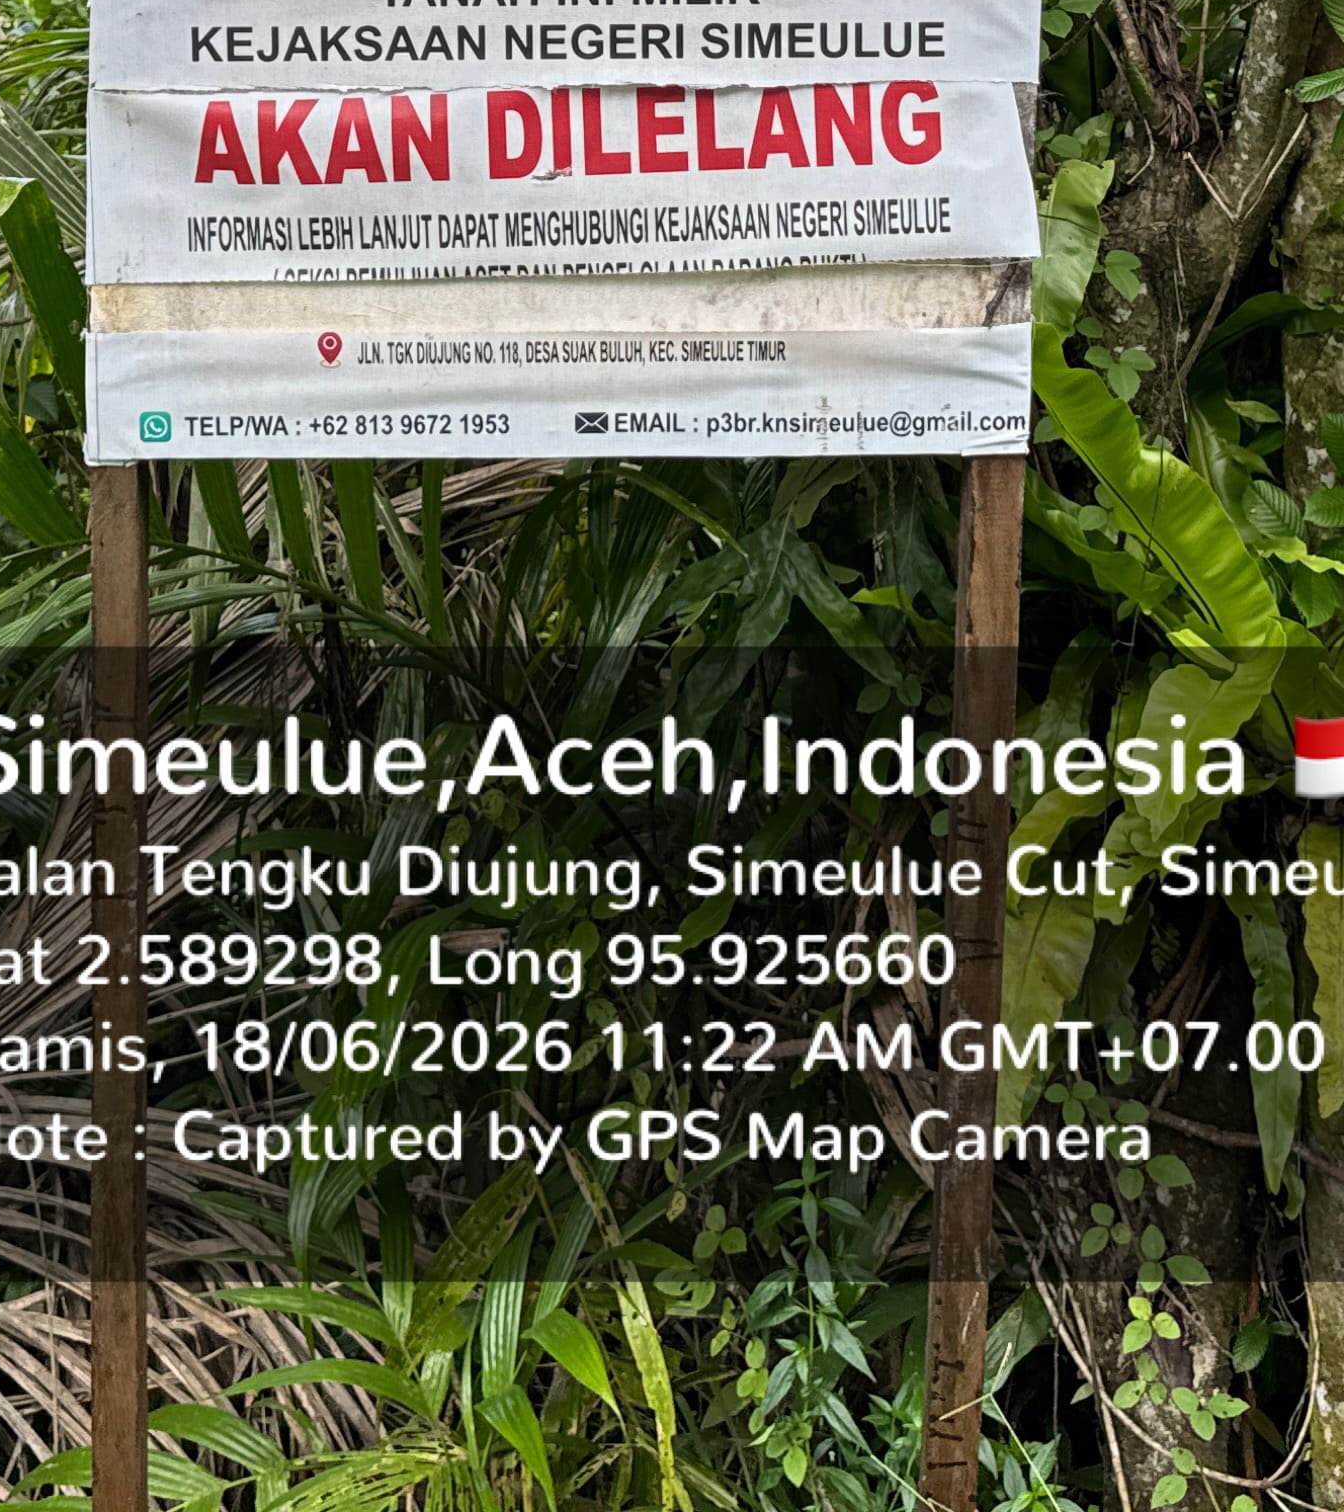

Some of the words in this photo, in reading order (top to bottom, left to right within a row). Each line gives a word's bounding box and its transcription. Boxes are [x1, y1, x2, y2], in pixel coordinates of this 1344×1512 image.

[191, 24, 486, 63] KEJAKSAAN
[505, 23, 684, 60] NEGERI
[701, 21, 945, 60] SIMEULUE
[195, 93, 450, 185] AKAN
[486, 80, 942, 180] DILELANG
[187, 216, 293, 252] INFORMASI
[297, 216, 354, 251] LEBIH
[358, 214, 432, 250] LANJUT
[438, 213, 499, 249] DAPAT
[505, 208, 649, 247] MENGHUBUNGI
[654, 203, 770, 242] KEJAKSAAN
[776, 201, 848, 238] NEGERI
[853, 197, 951, 236] SIMEULUE
[356, 341, 384, 365] JLN.
[387, 341, 414, 365] TGK
[416, 341, 471, 365] DIUJUNG
[474, 341, 496, 364] NO.
[499, 341, 522, 368] 118,
[525, 341, 560, 364] DESA
[562, 340, 597, 363] SUAK
[599, 340, 645, 366] BULUH,
[648, 340, 678, 363] KEC.
[681, 340, 744, 362] SIMEULUE
[747, 340, 786, 362] TIMUR
[184, 415, 289, 437] TELP/WA
[296, 420, 301, 436] :
[309, 415, 348, 436] +62
[355, 414, 394, 435] 813
[400, 414, 452, 435] 9672
[459, 413, 510, 434] 1953
[615, 412, 686, 433] EMAIL
[693, 417, 698, 433] :
